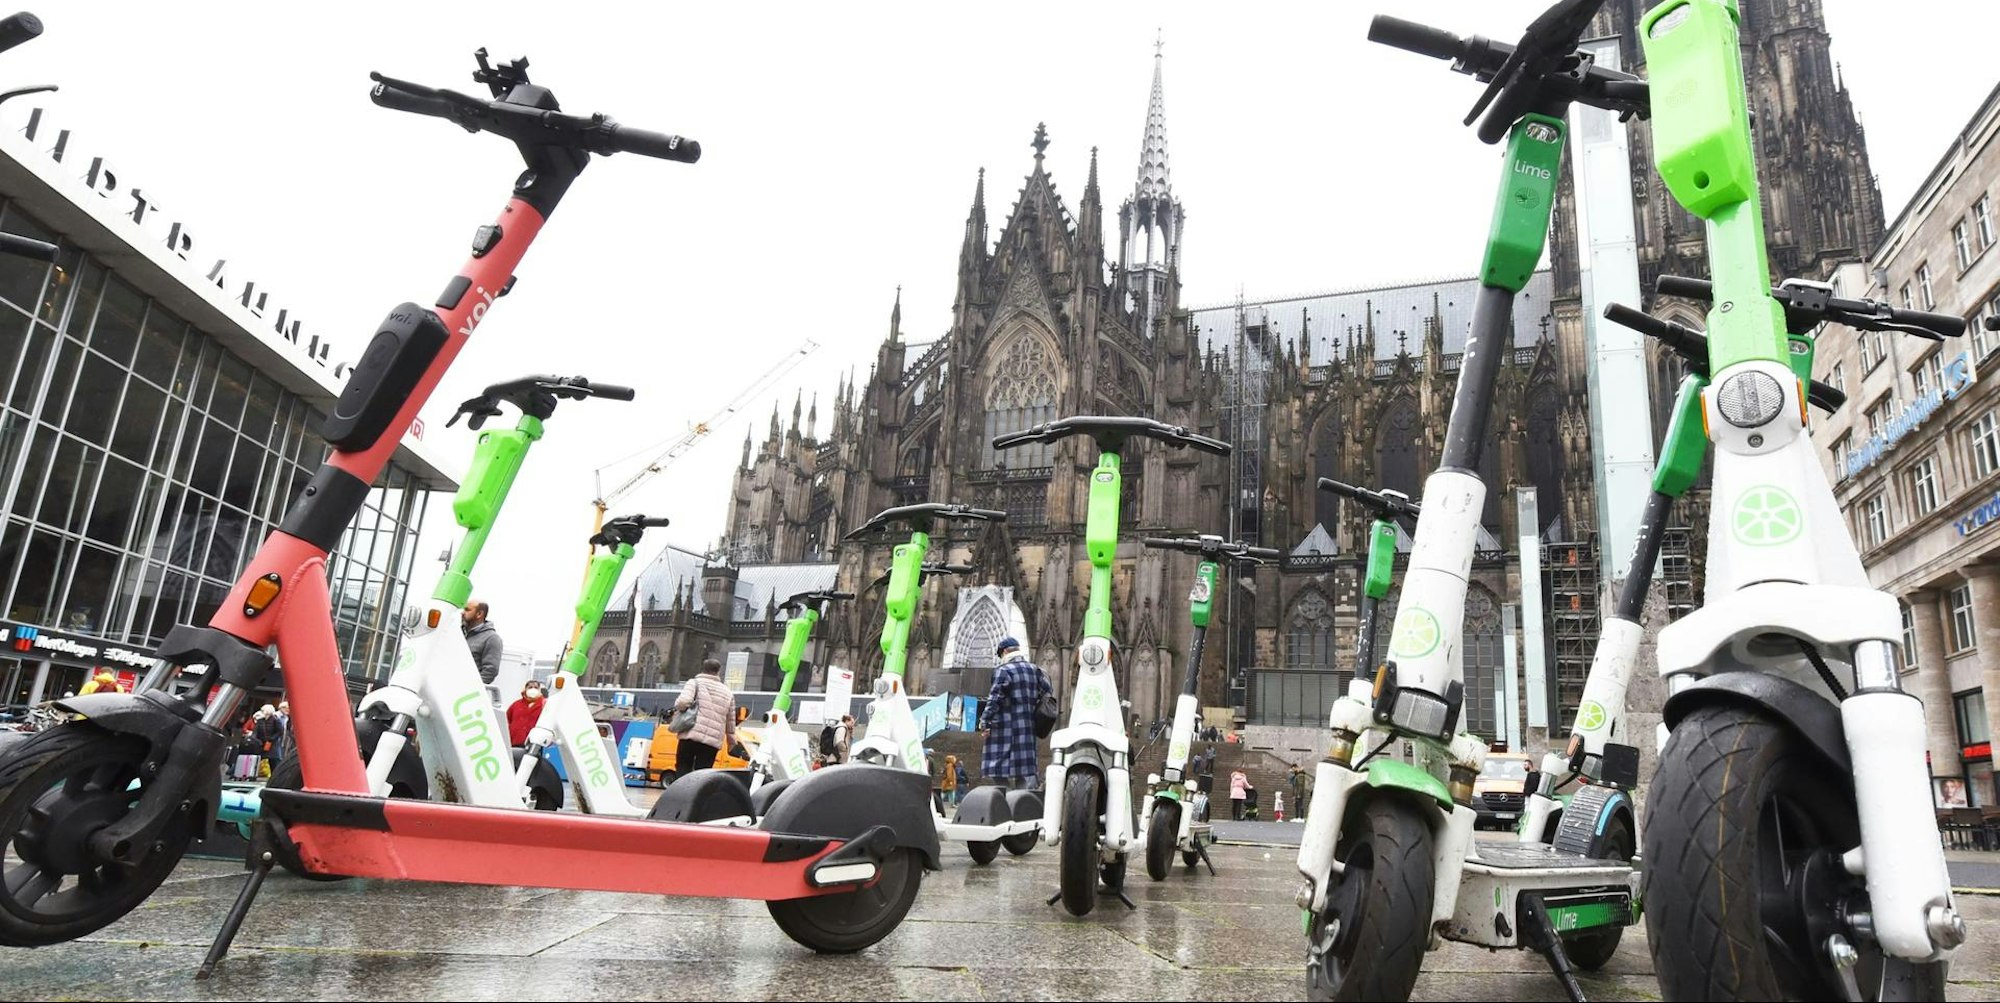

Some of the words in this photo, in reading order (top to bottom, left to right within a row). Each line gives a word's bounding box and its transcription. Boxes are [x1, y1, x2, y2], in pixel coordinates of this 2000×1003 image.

[1514, 159, 1551, 179] Lime
[453, 691, 500, 783] Lime
[575, 729, 609, 789] Lime
[1556, 908, 1578, 932] Lime
